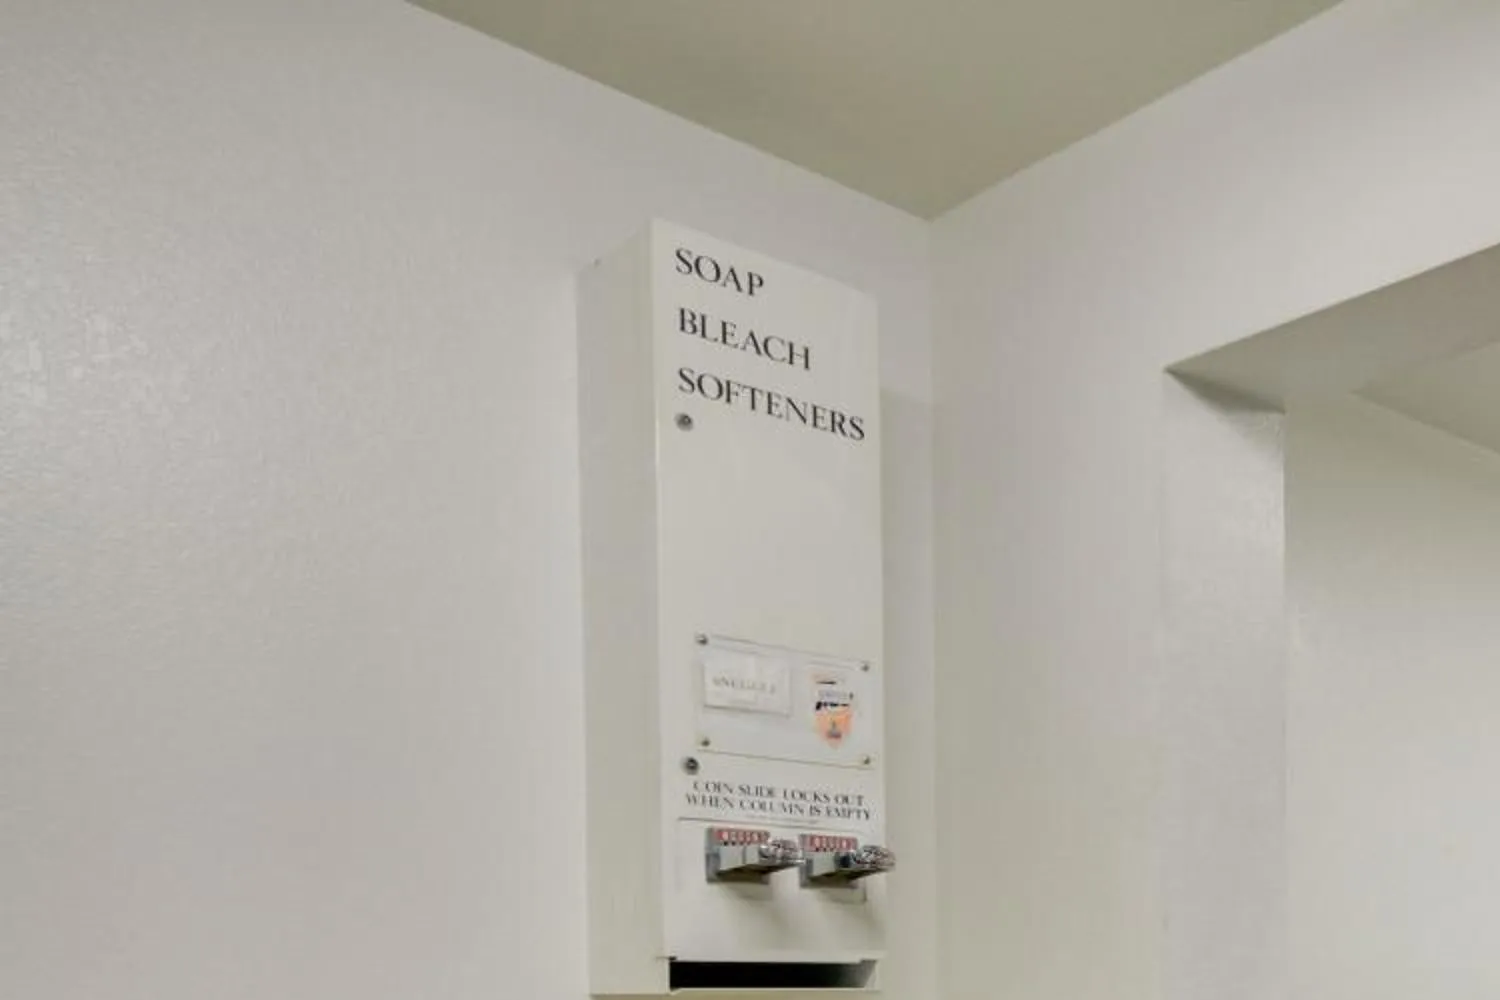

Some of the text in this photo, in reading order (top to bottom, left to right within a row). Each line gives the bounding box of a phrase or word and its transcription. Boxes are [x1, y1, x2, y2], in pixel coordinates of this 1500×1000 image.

[675, 248, 764, 296] SOAP
[678, 307, 811, 371] BLEACH
[678, 367, 865, 441] SOFTENERS
[685, 792, 870, 821] WHEN COLUMN IS EMPTY
[692, 780, 864, 807] COIN SLIDE LOCKS OUT
